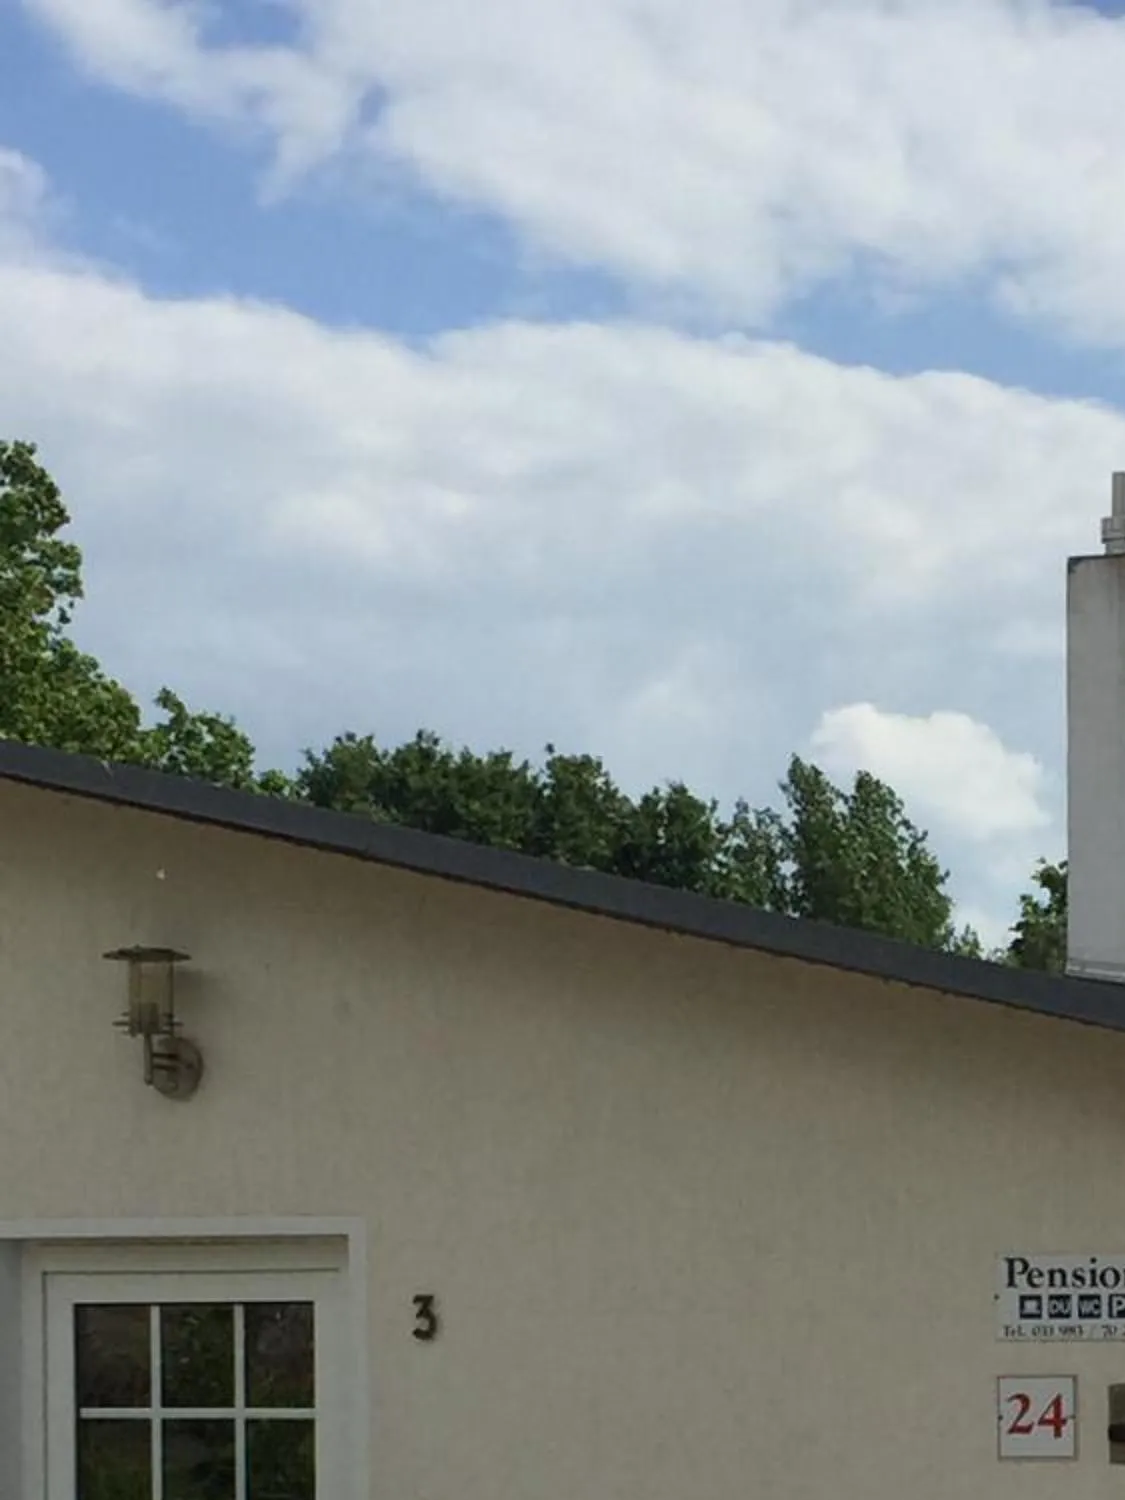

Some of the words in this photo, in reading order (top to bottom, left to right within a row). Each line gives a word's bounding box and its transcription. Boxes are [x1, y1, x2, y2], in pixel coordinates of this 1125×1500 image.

[412, 1294, 437, 1340] 3
[1049, 1299, 1072, 1314] DU
[1079, 1299, 1101, 1314] WC
[1006, 1393, 1068, 1439] 24
